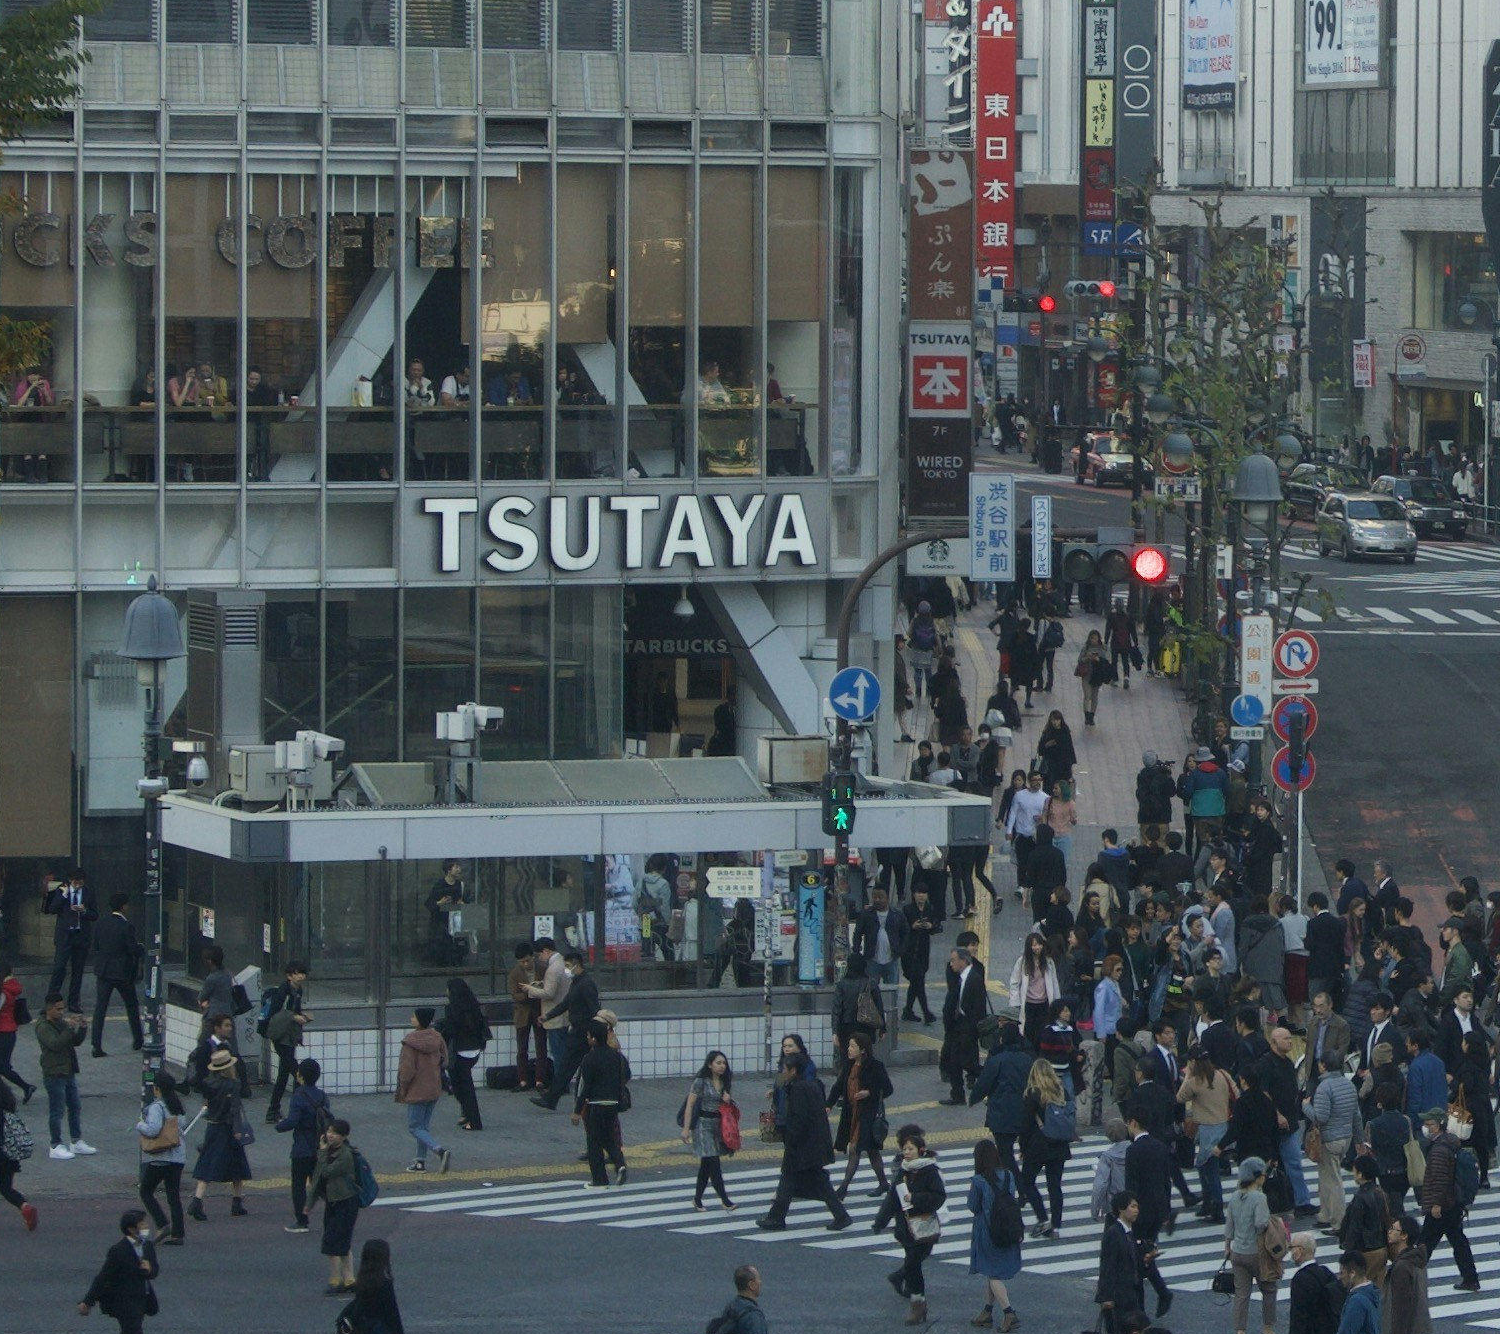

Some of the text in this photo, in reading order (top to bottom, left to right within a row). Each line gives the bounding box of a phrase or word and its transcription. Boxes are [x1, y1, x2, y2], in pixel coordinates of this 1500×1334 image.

[216, 213, 498, 270] COFFEE
[926, 223, 955, 300] ぷん楽
[910, 333, 970, 346] TSUTAYA
[918, 360, 961, 404] 本
[916, 455, 964, 469] WIRED
[922, 469, 958, 480] TOKYO
[423, 492, 818, 575] TSUTAYA
[975, 495, 987, 560] Shibuya Sta.
[988, 481, 1009, 572] 渋谷駅前
[1035, 499, 1048, 574] スクランブル式
[623, 637, 729, 656] TARBUCKS
[808, 874, 816, 885] 6
